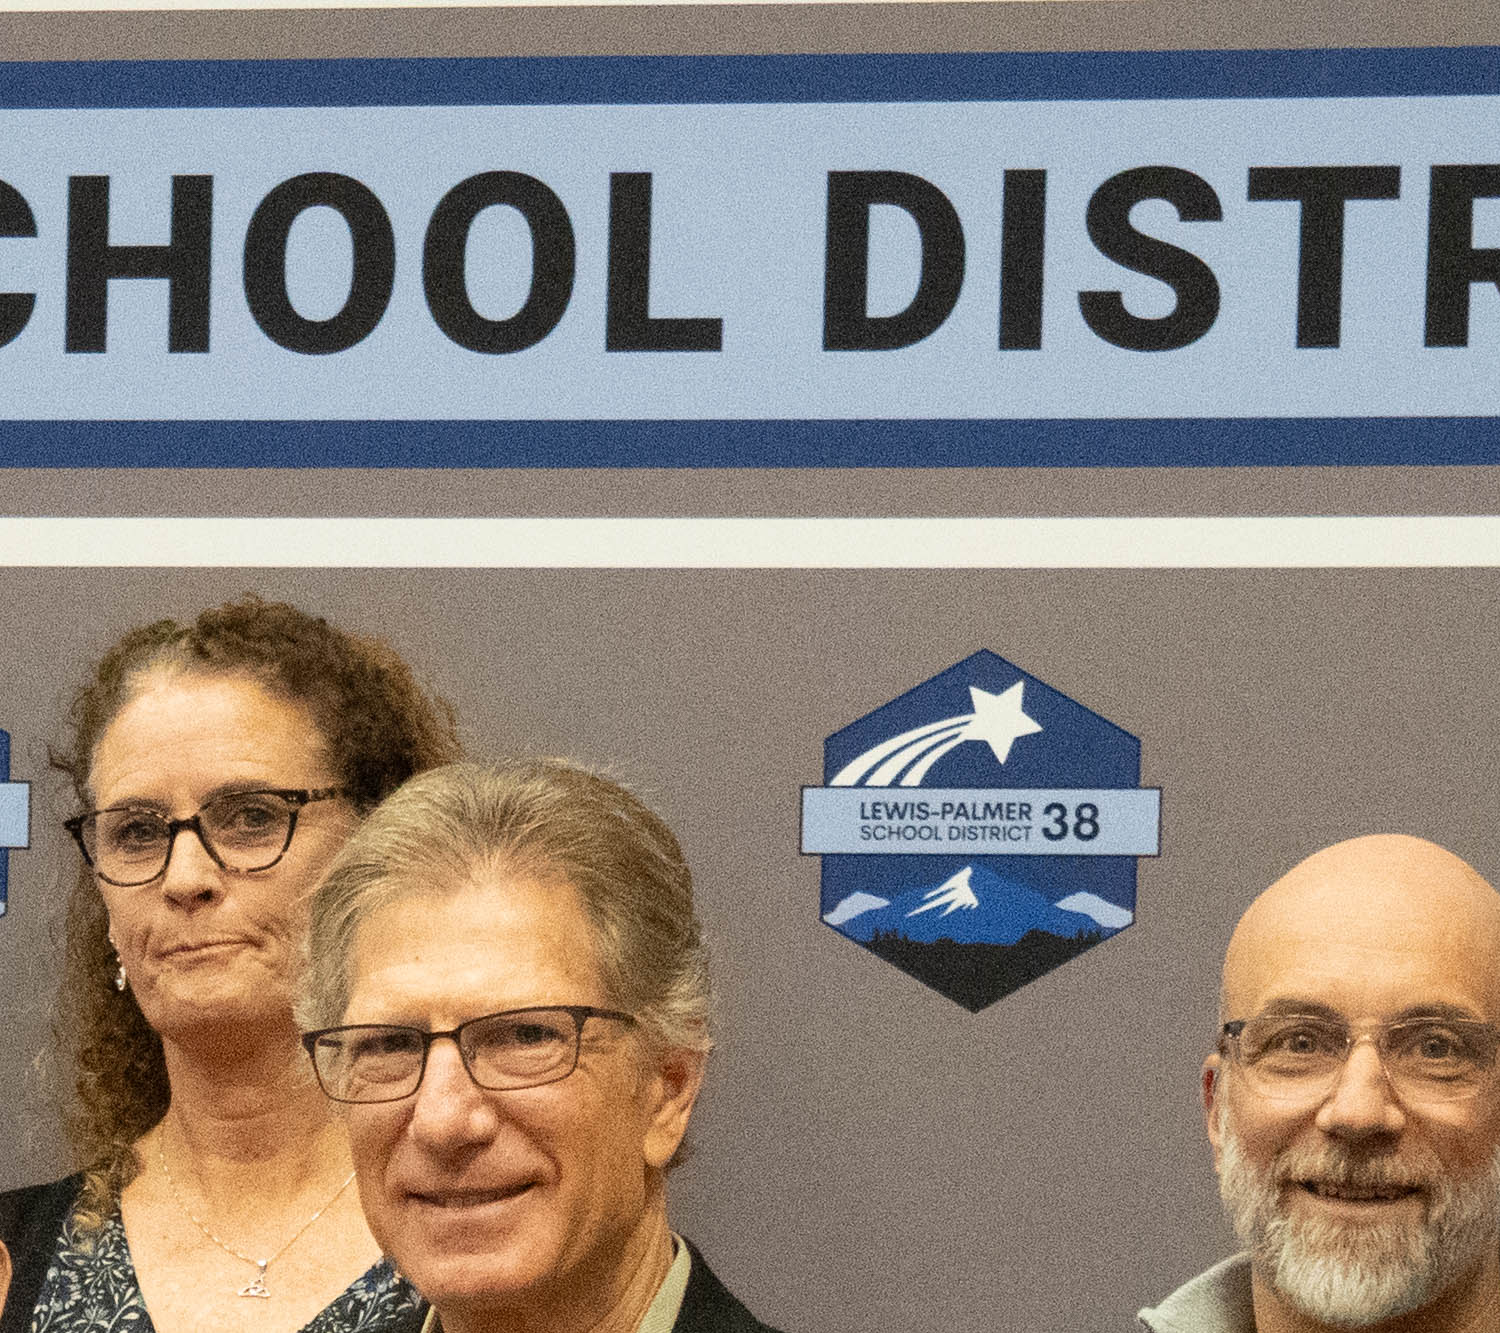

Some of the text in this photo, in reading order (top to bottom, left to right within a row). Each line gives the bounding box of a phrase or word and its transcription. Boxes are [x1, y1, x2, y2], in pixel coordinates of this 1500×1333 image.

[860, 801, 1032, 822] LEWIS-PALMER
[1041, 802, 1101, 842] 38
[860, 824, 1033, 842] SCHOOL DISTRICT
